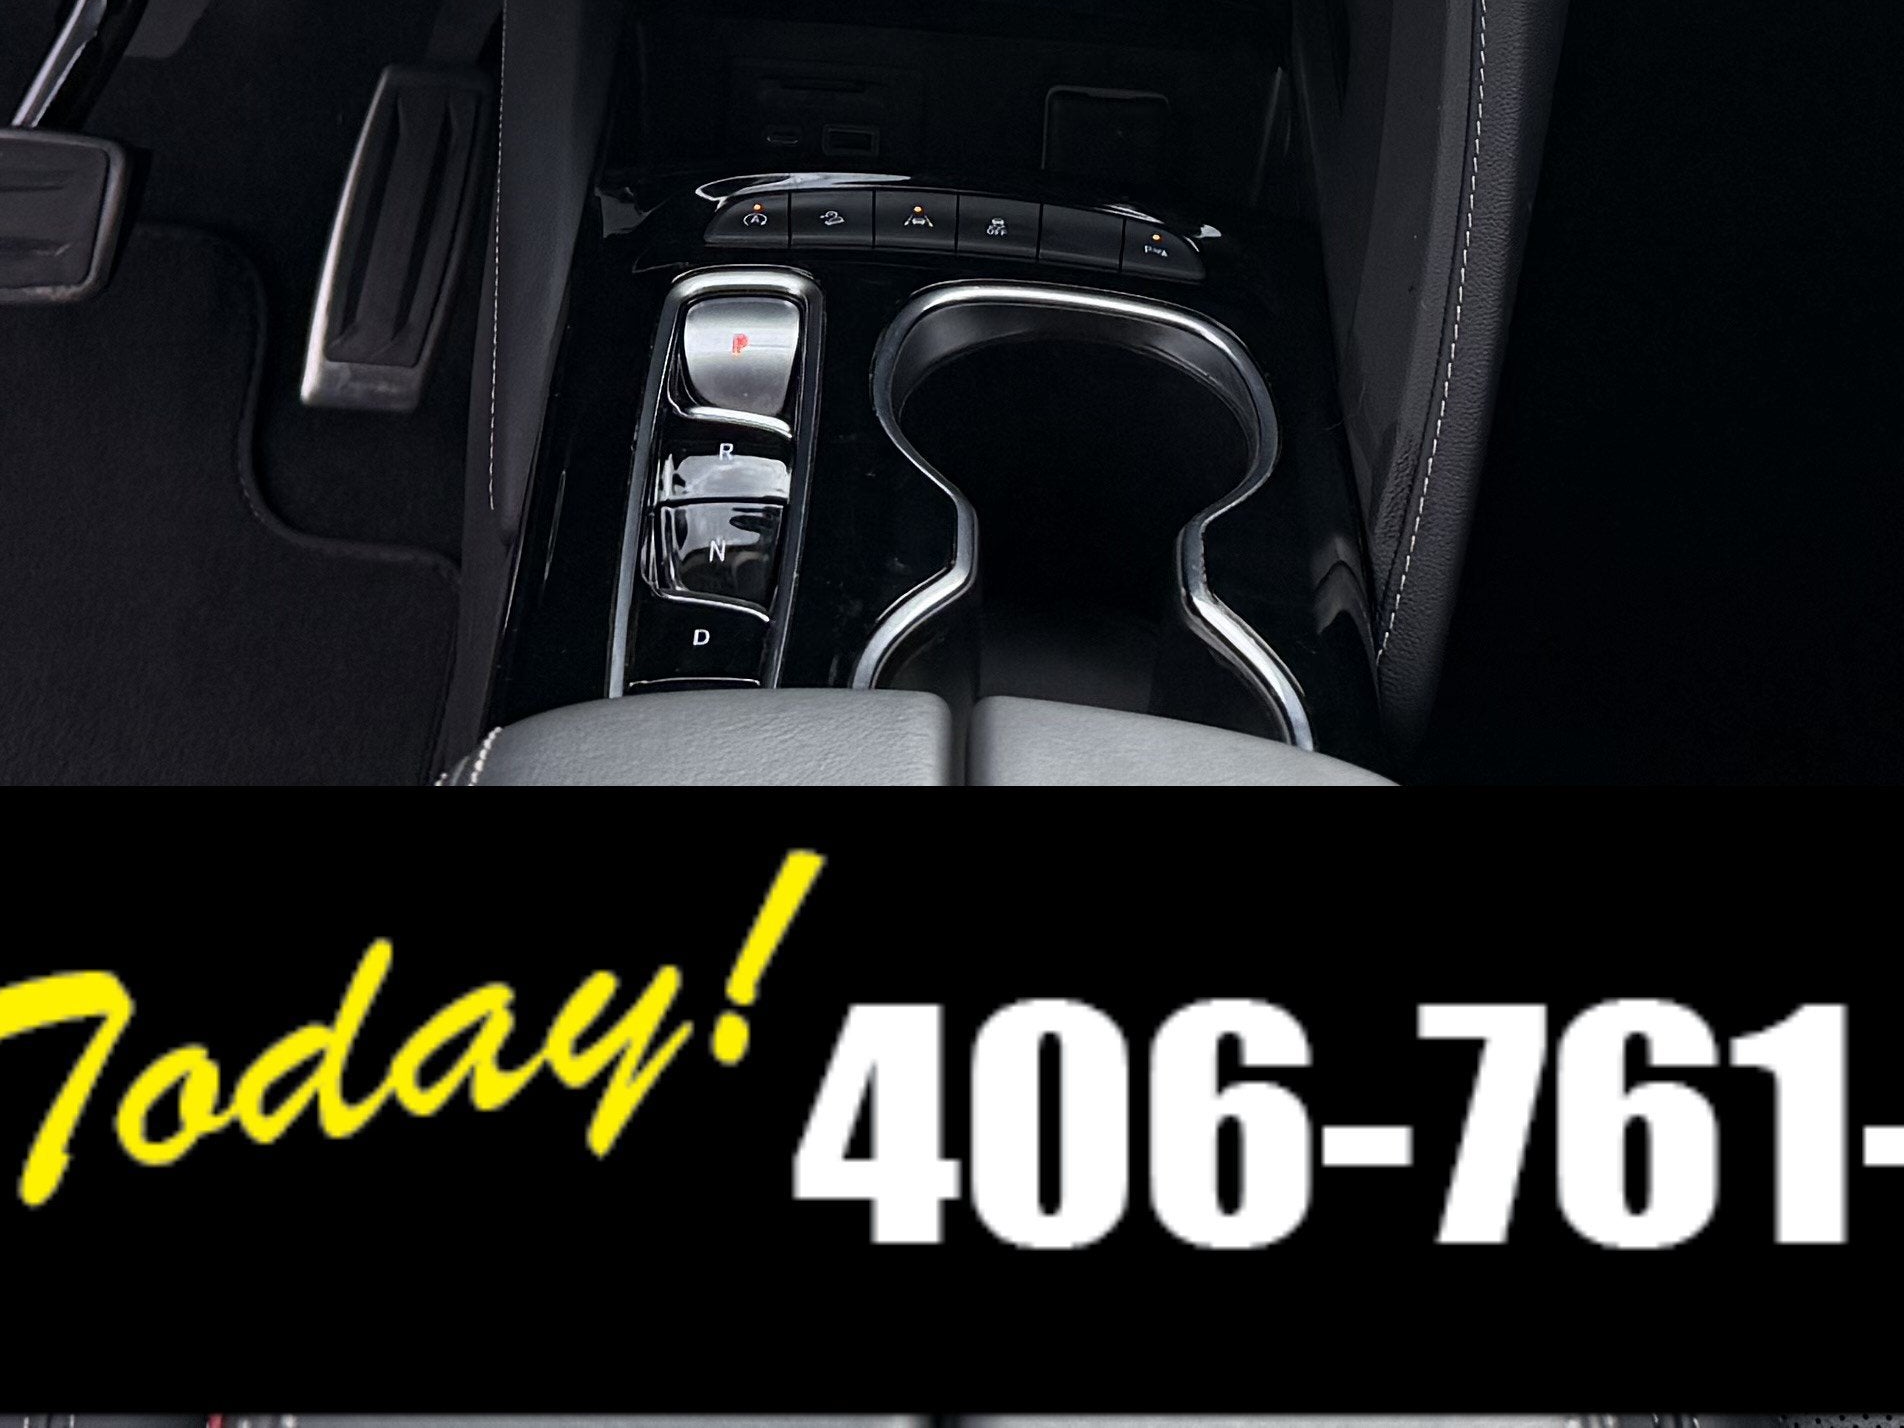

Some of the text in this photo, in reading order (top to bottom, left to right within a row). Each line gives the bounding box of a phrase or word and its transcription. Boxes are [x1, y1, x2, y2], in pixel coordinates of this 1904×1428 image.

[731, 332, 748, 356] P
[718, 442, 734, 462] R
[708, 539, 727, 563] N
[692, 628, 710, 647] D
